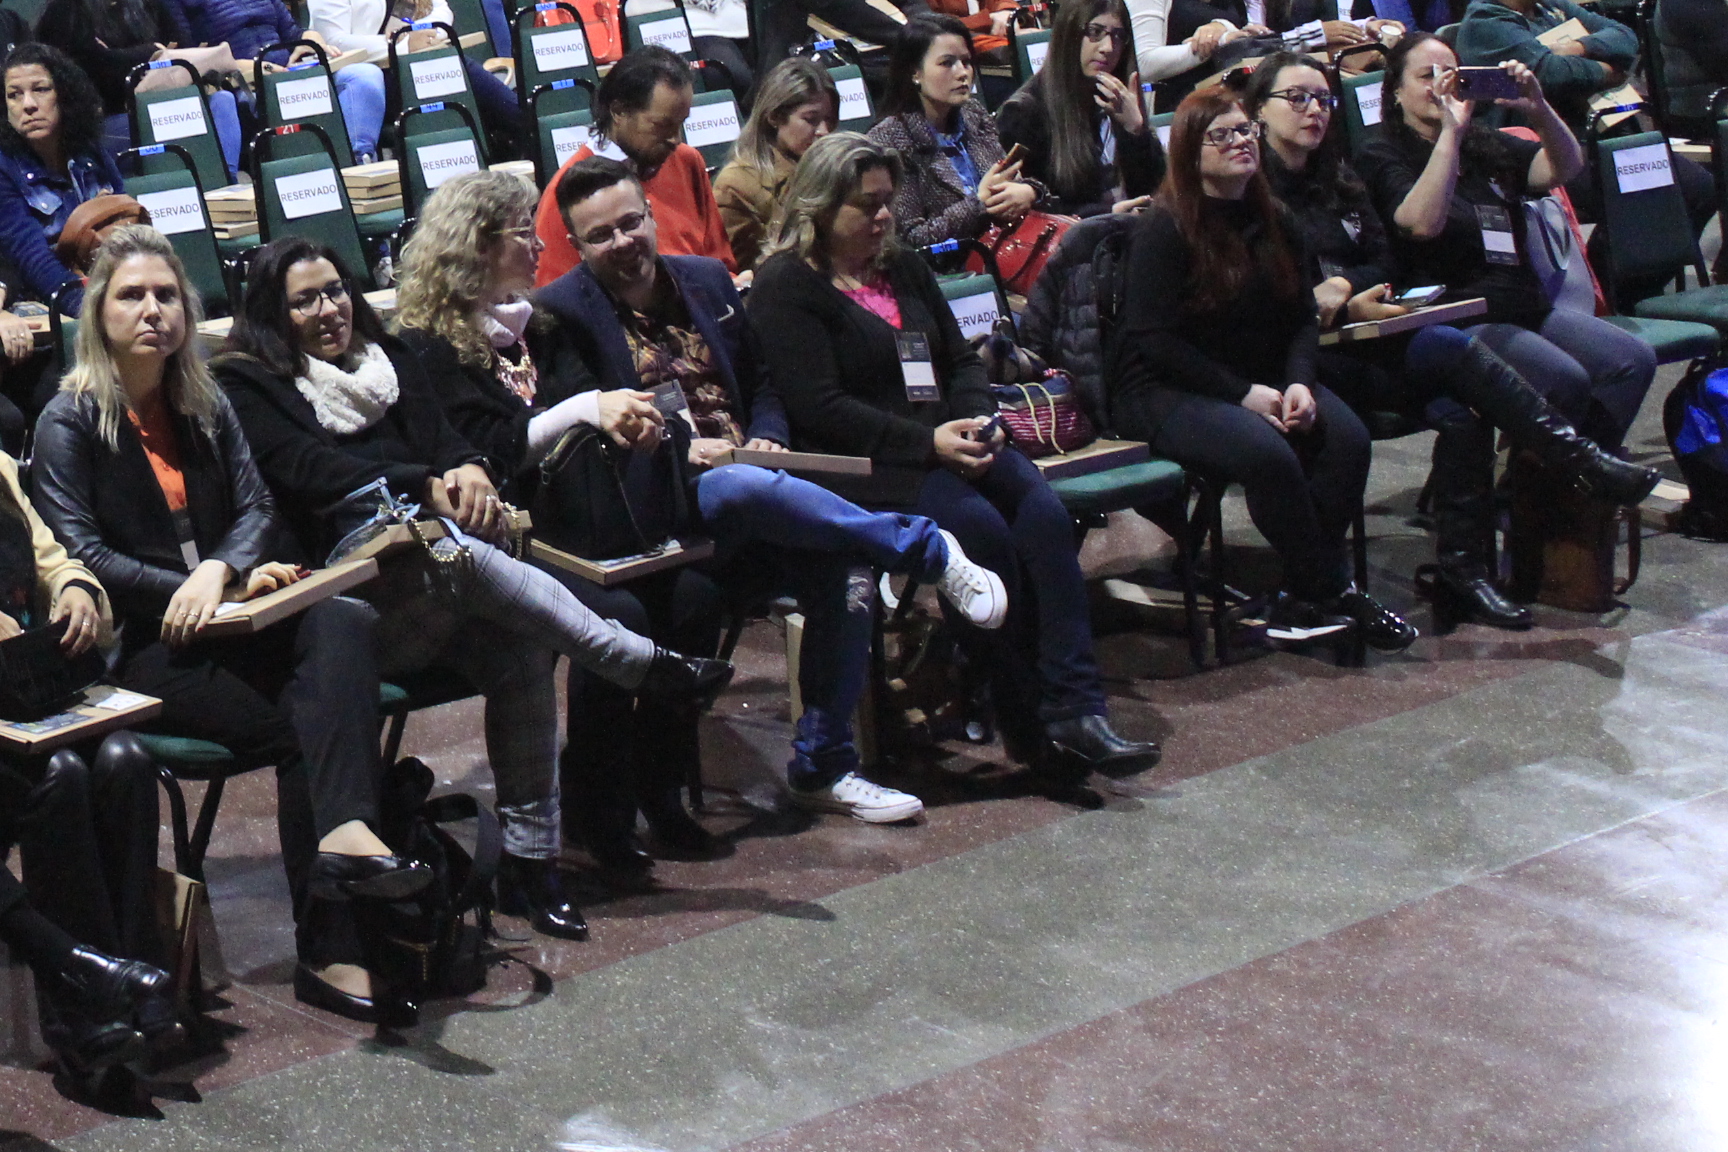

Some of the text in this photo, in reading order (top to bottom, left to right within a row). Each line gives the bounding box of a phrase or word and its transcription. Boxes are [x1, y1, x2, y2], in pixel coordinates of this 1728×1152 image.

[535, 42, 584, 56] RESERVADO
[414, 68, 462, 85] RESERVADO
[280, 88, 329, 104] RESERVADO
[838, 92, 865, 104] RVADO
[152, 110, 203, 127] RESERVADO
[685, 115, 737, 132] RESERVADO
[422, 154, 477, 171] RESERVADO
[1617, 159, 1669, 177] RESERVADO
[280, 184, 337, 203] RESERVADO
[148, 202, 200, 220] ESERVADO
[956, 309, 999, 328] ERVADO
